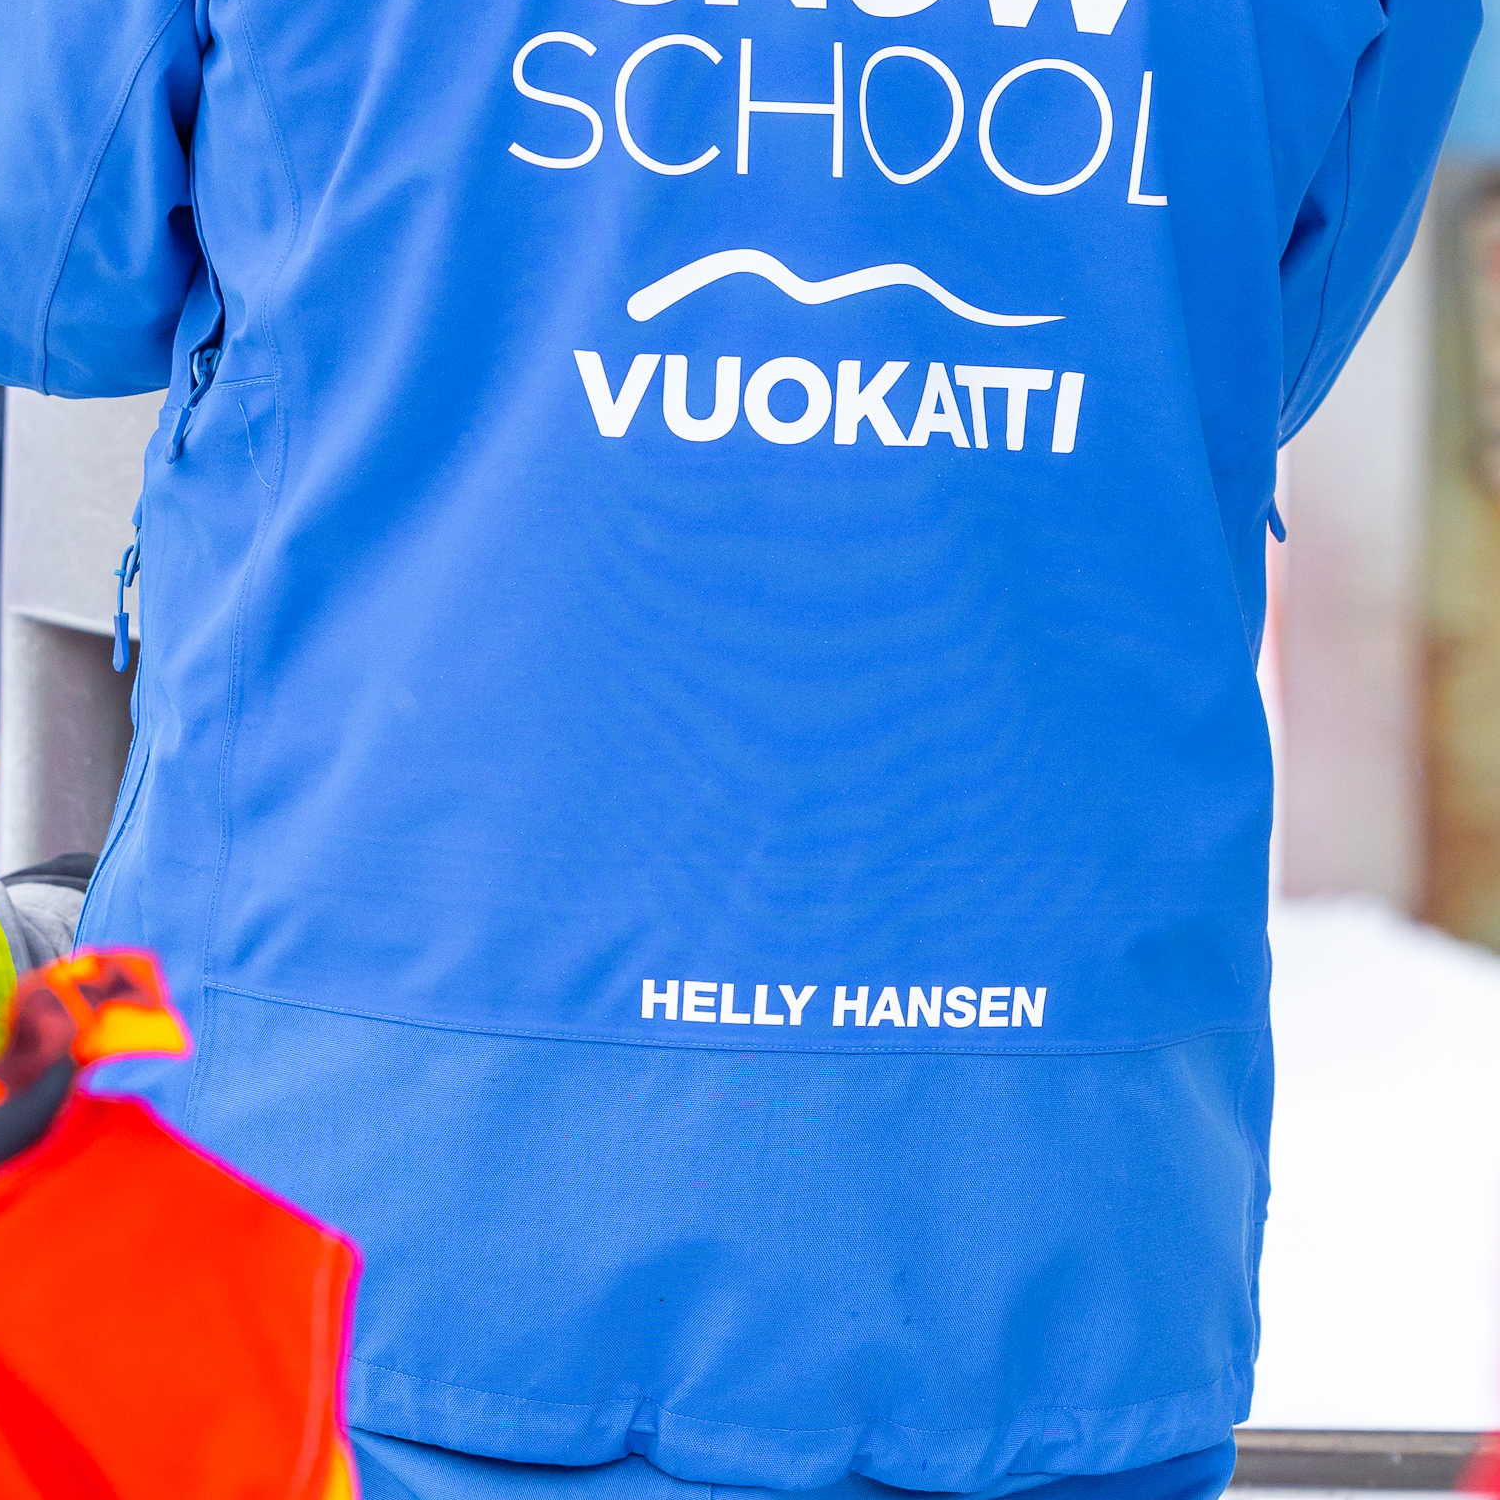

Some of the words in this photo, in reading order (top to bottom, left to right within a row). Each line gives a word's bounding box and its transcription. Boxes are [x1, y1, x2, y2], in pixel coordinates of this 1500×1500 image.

[507, 30, 1169, 206] SCHOOL
[573, 349, 1086, 454] VUOKATTI
[640, 978, 819, 1026] HELLY
[832, 985, 1048, 1028] HANSEN
